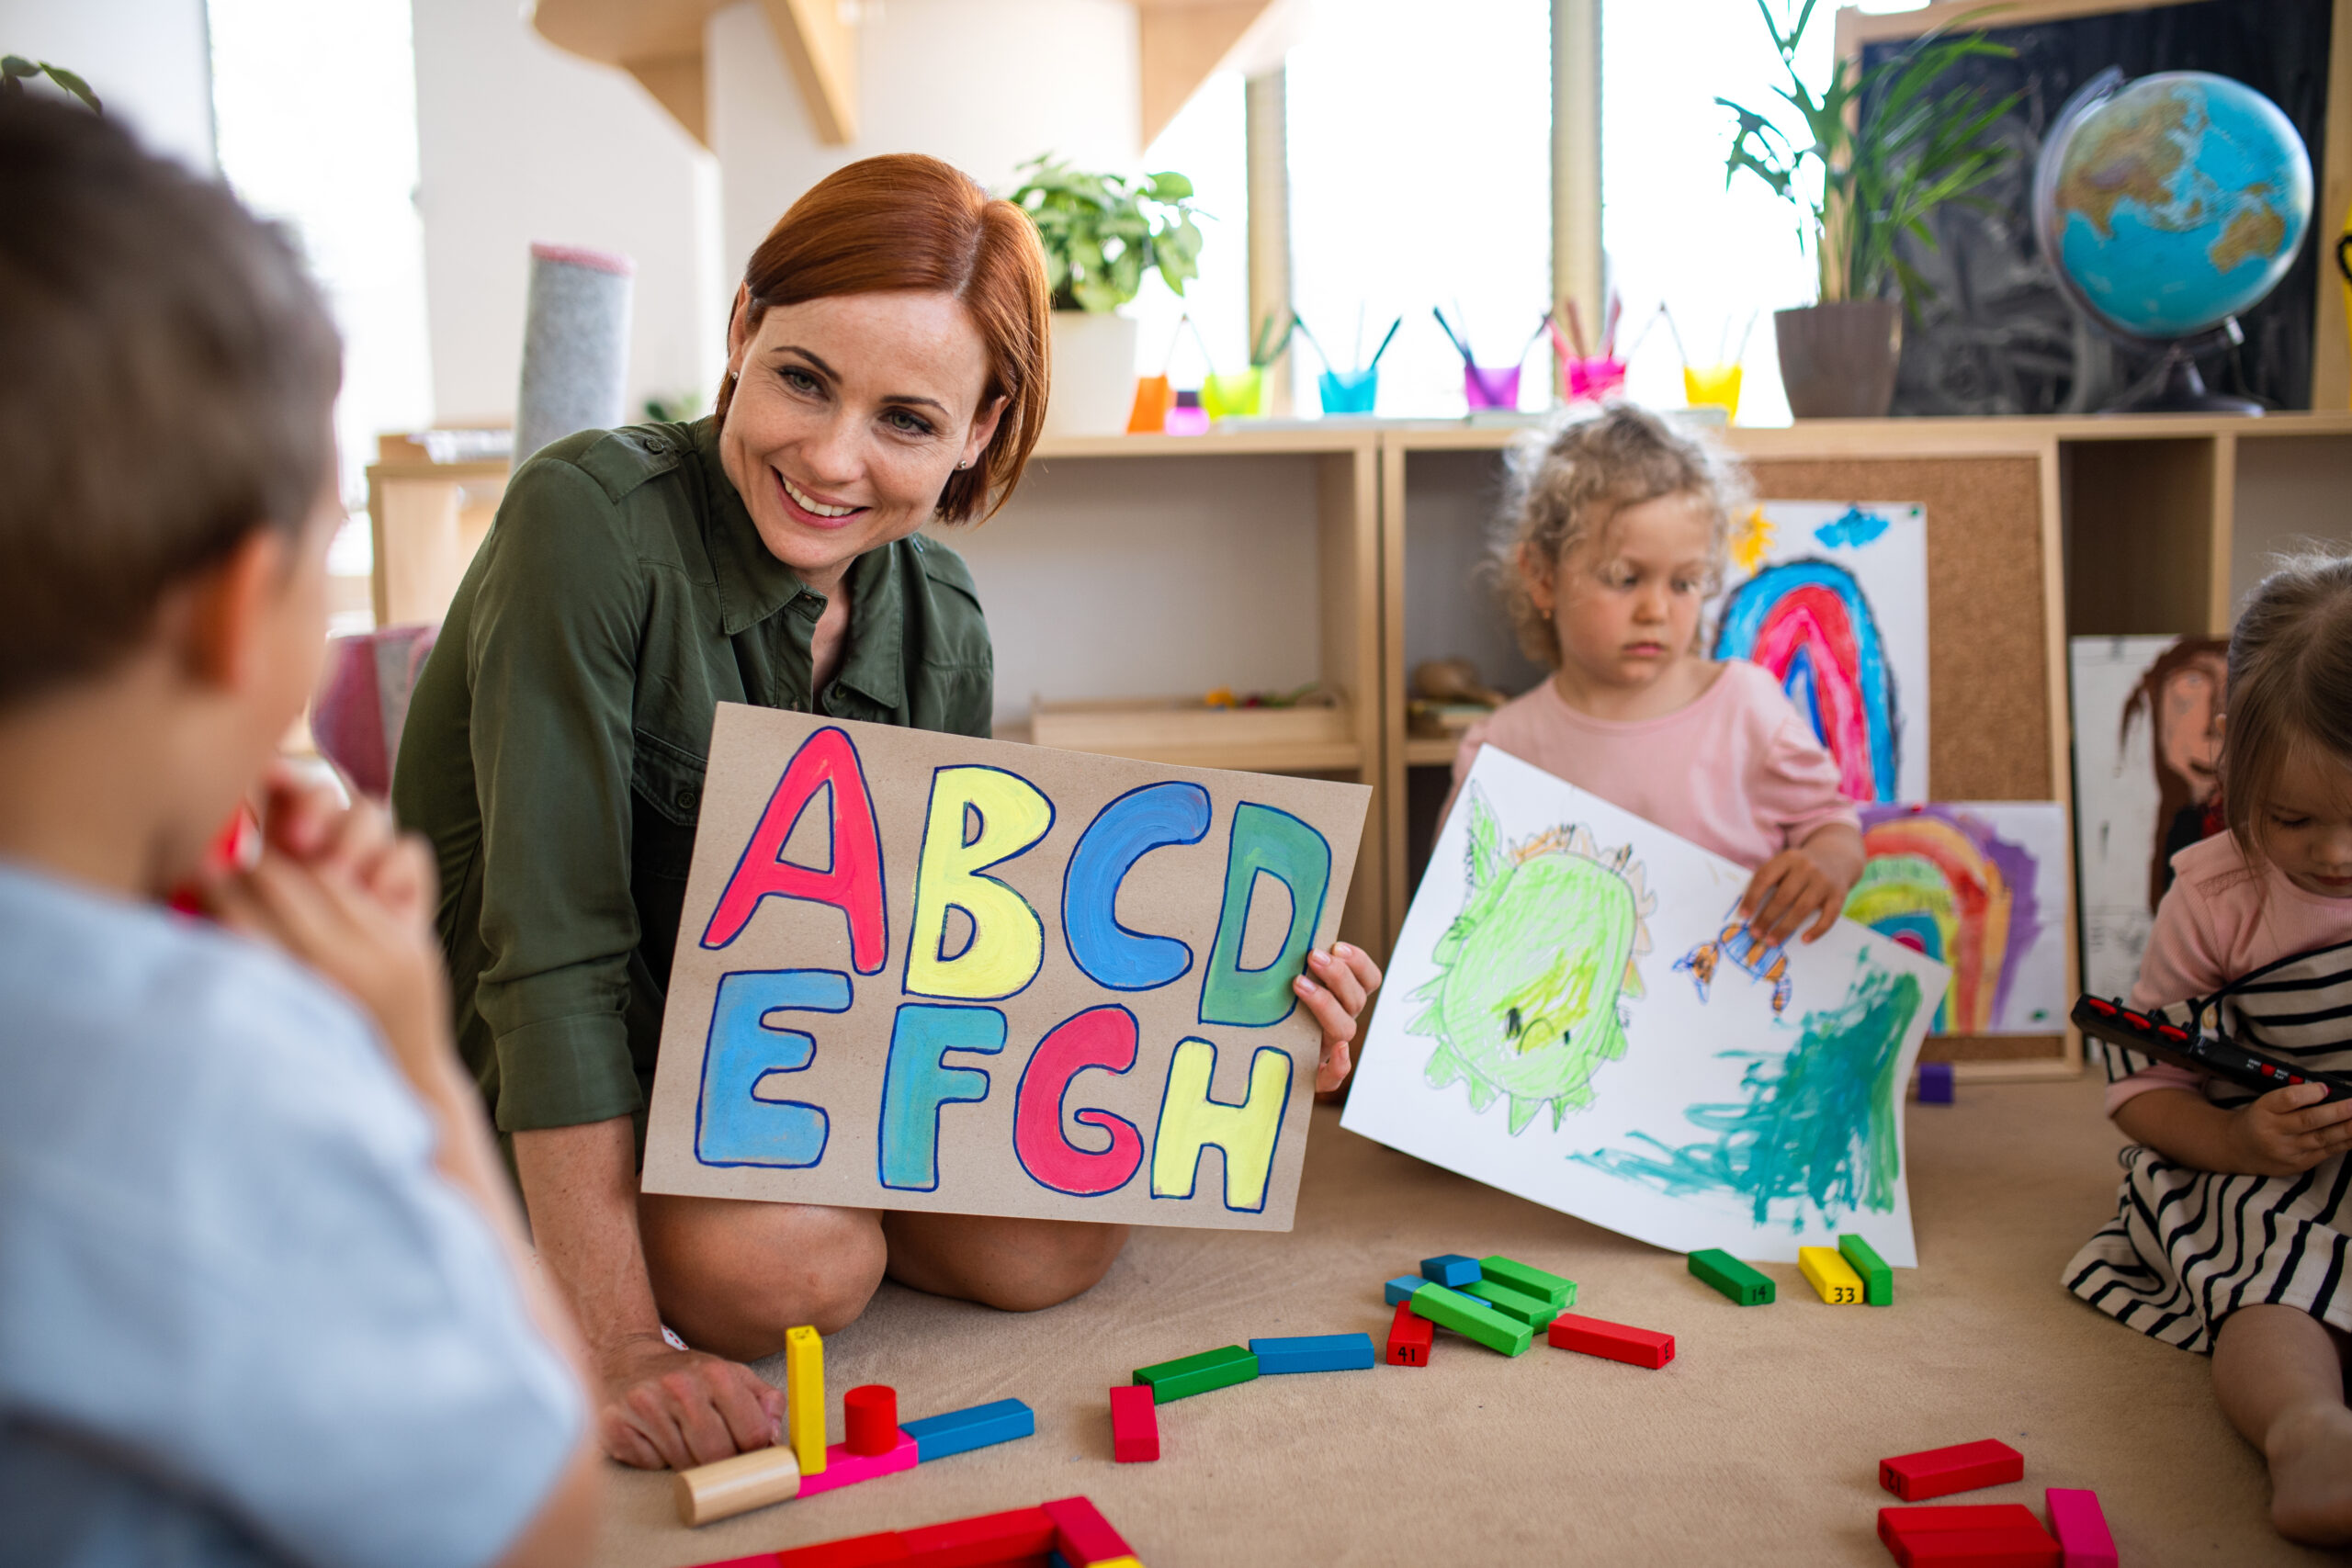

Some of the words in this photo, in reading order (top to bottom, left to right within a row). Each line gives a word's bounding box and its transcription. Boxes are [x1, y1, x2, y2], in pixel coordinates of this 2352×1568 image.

[1751, 1285, 1769, 1303] 14
[1834, 1287, 1856, 1303] 33
[1397, 1346, 1416, 1363] 41
